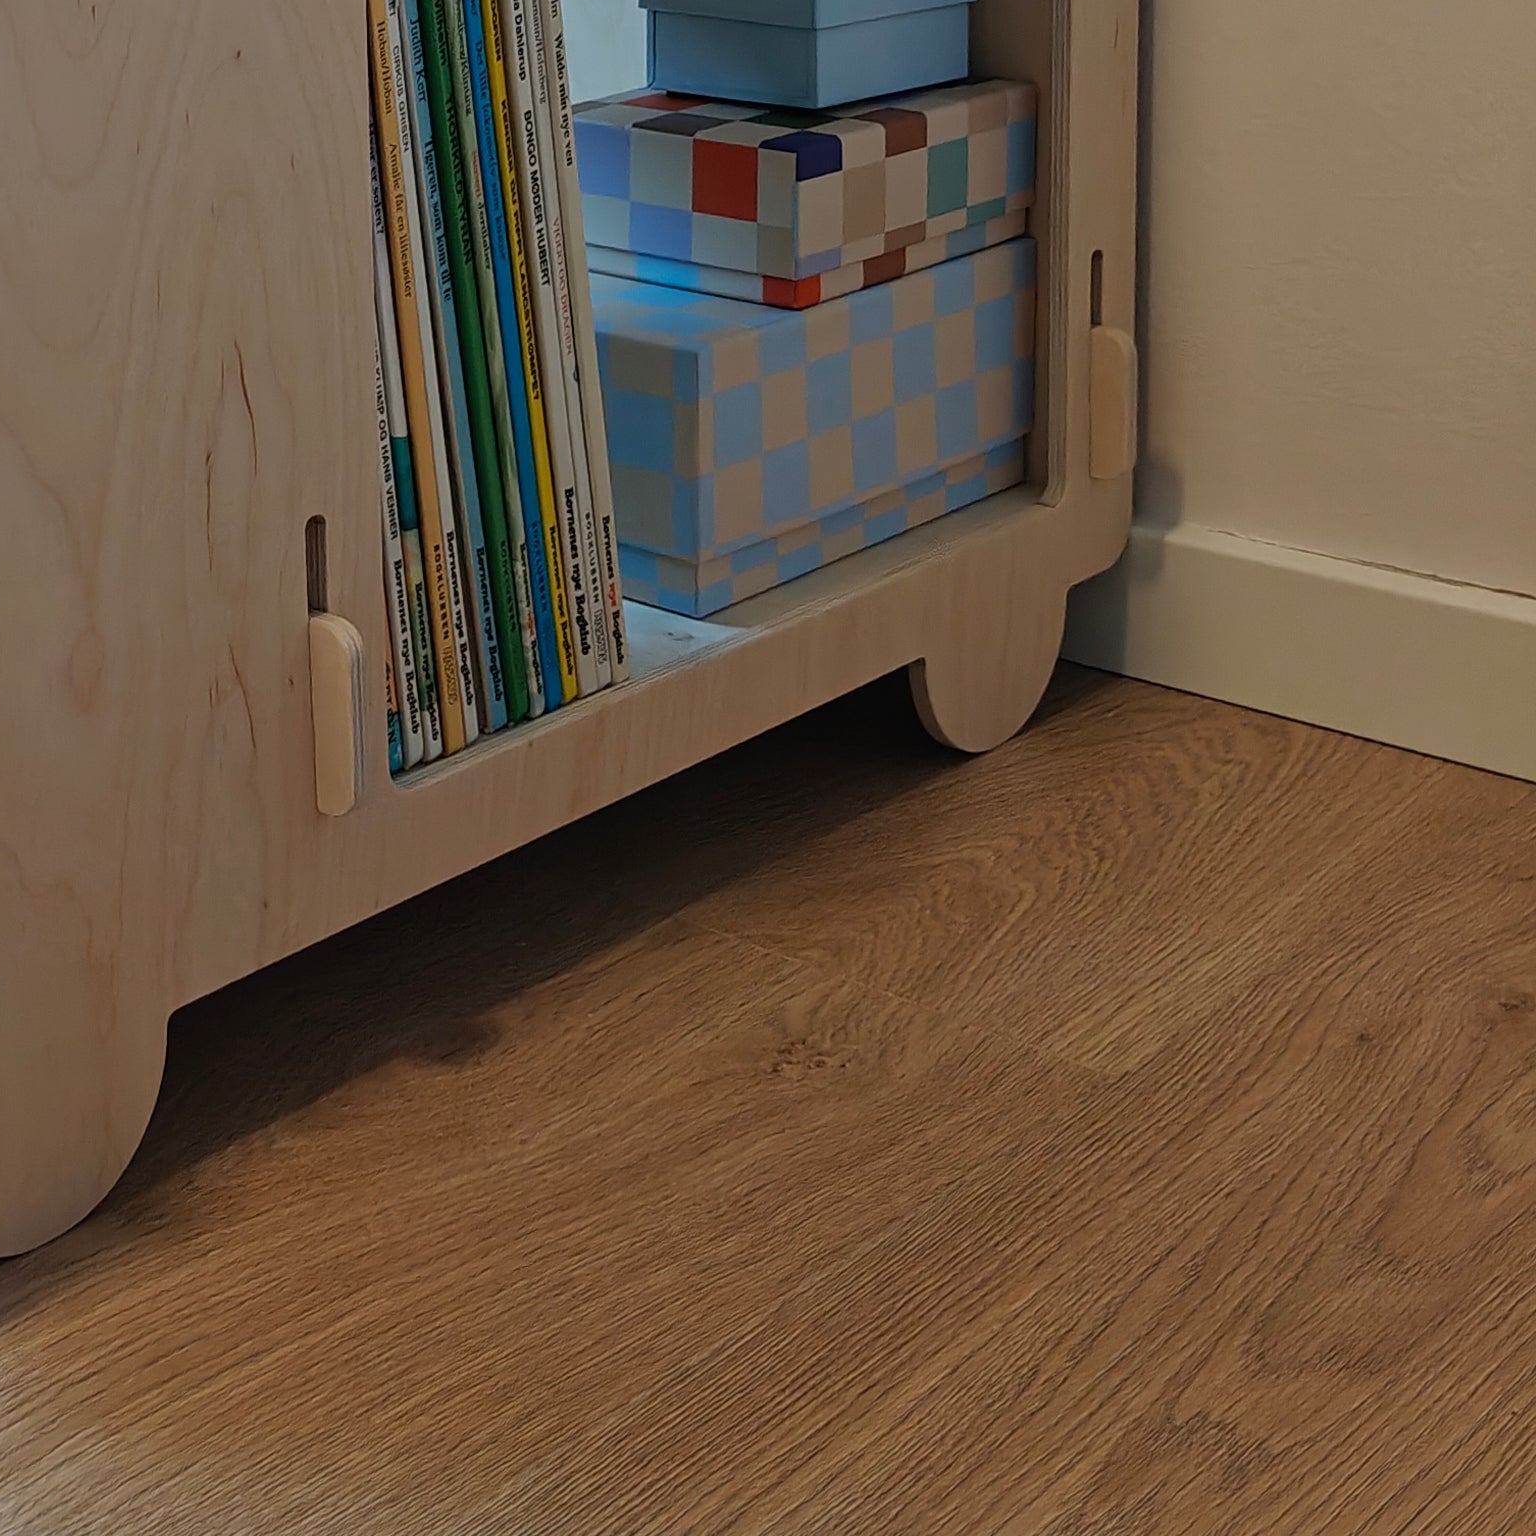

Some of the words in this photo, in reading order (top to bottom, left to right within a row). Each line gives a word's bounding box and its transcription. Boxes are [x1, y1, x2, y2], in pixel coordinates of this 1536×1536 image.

[410, 17, 424, 66] Judith
[515, 15, 526, 80] Dahlerup
[555, 33, 565, 79] Waldo
[393, 45, 404, 95] CIRKUS
[399, 101, 409, 152] GRISEN
[416, 71, 428, 101] Kerr
[559, 84, 568, 109] min
[524, 110, 537, 165] BONGO
[560, 114, 570, 137] nye
[565, 142, 573, 166] ven
[510, 181, 517, 204] DU
[530, 171, 543, 224] MØDER
[397, 216, 405, 230] en
[433, 201, 442, 230] som
[436, 235, 449, 266] kom
[536, 228, 550, 286] HUBERT
[441, 270, 452, 285] til
[443, 288, 452, 301] te
[378, 419, 388, 440] OG
[381, 445, 392, 482] HANS
[386, 487, 398, 539] VENNER
[434, 545, 449, 639] BOGKLUBBEN
